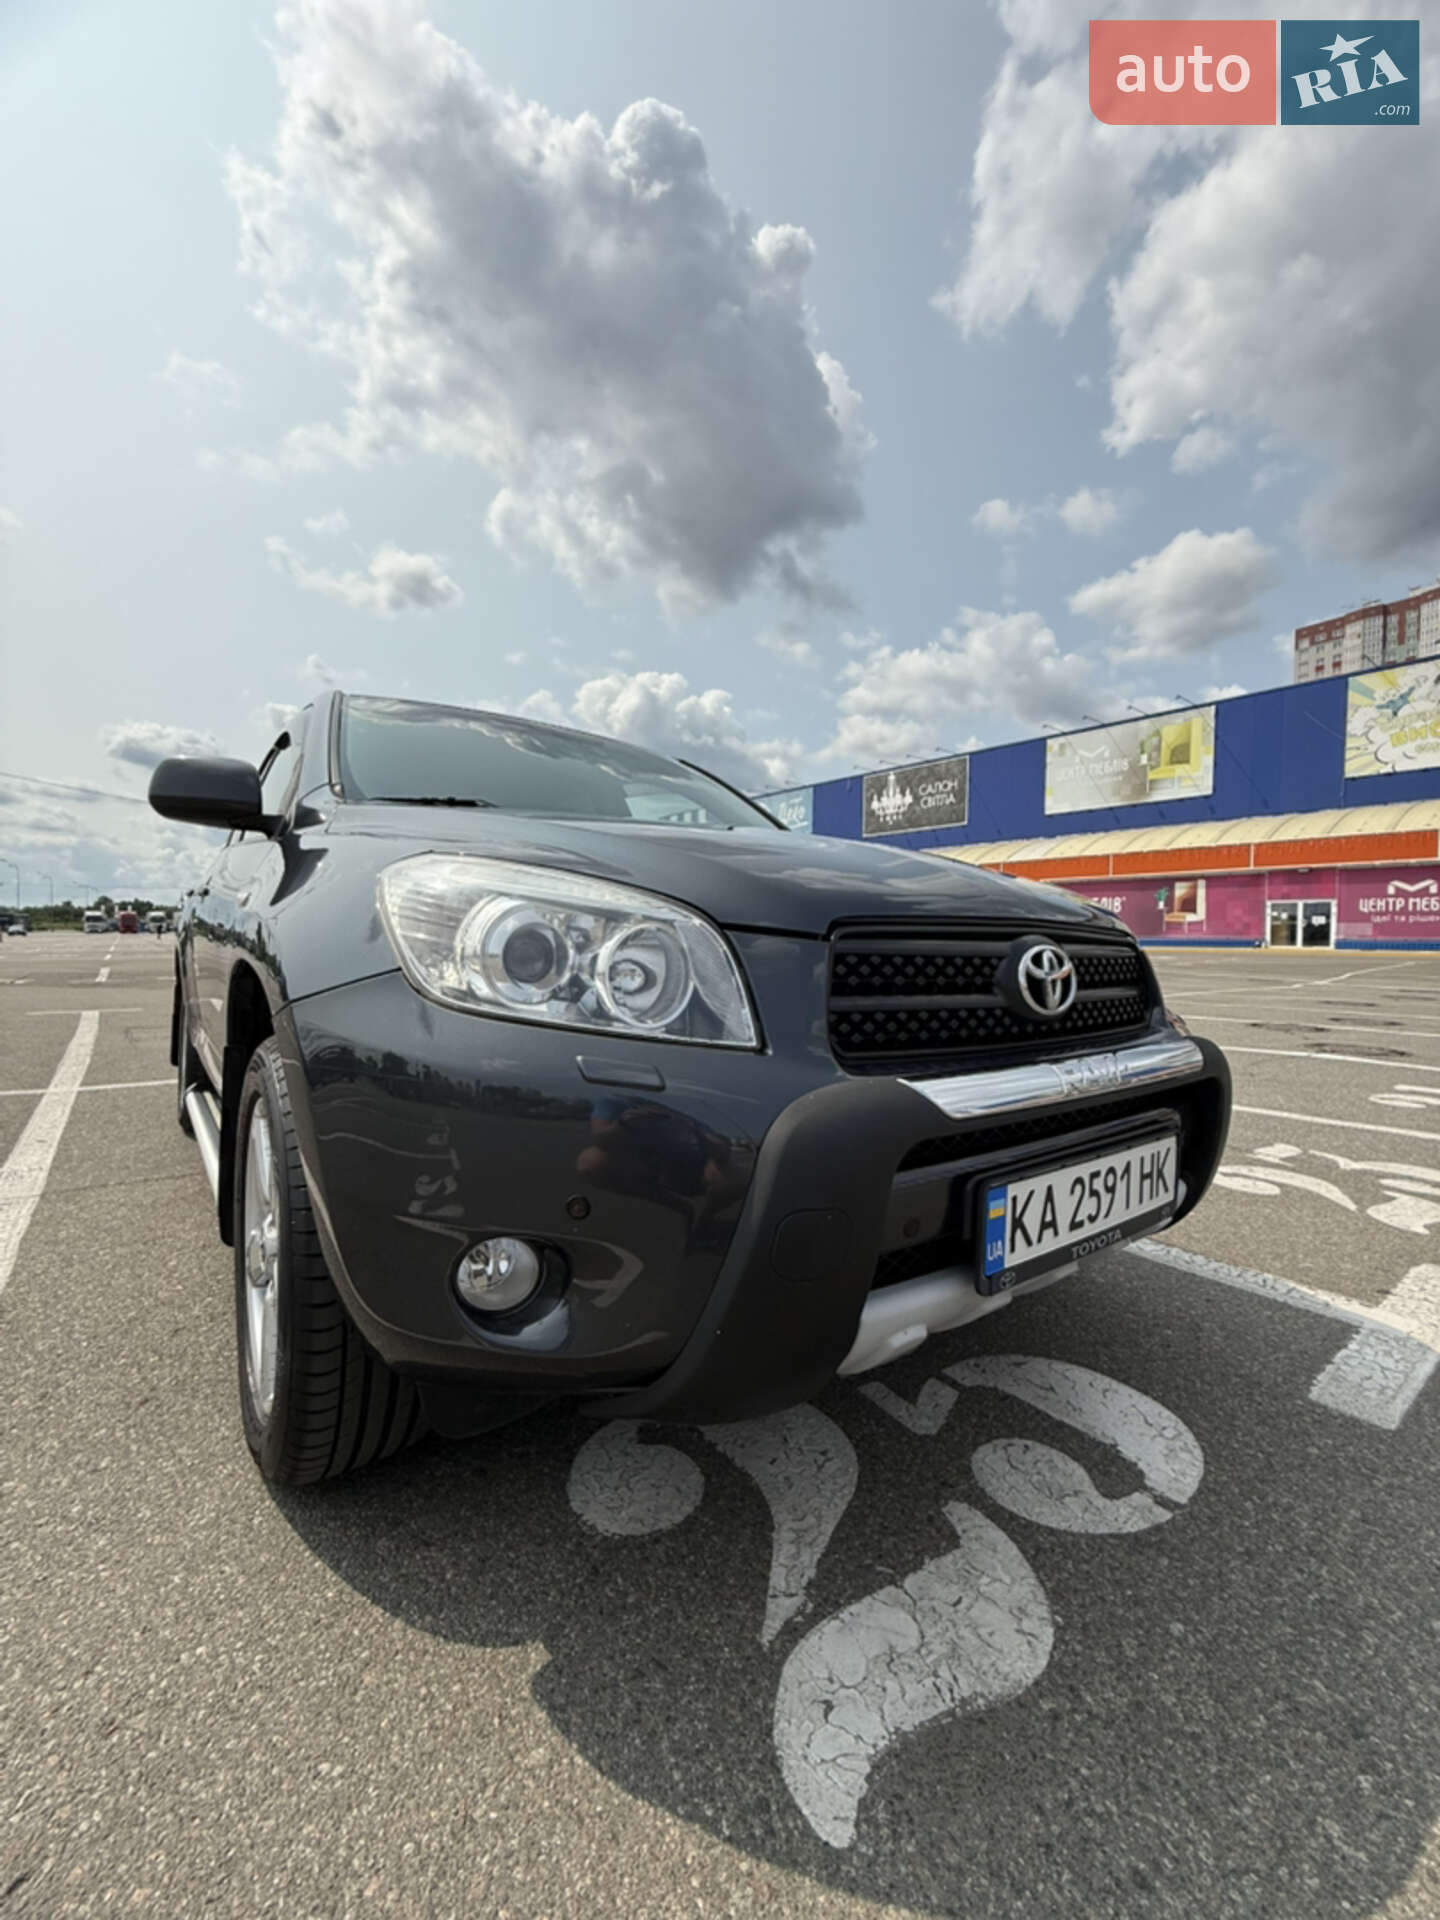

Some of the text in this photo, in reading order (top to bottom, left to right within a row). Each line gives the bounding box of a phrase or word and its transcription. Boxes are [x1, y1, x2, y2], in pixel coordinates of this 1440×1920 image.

[918, 779, 958, 796] САЛОН
[920, 795, 956, 810] СВІТЛА
[1359, 898, 1406, 913] ЦЕНТР
[986, 1147, 1172, 1261] UA KA 2591 HK
[1071, 1229, 1123, 1260] TOYOTA
